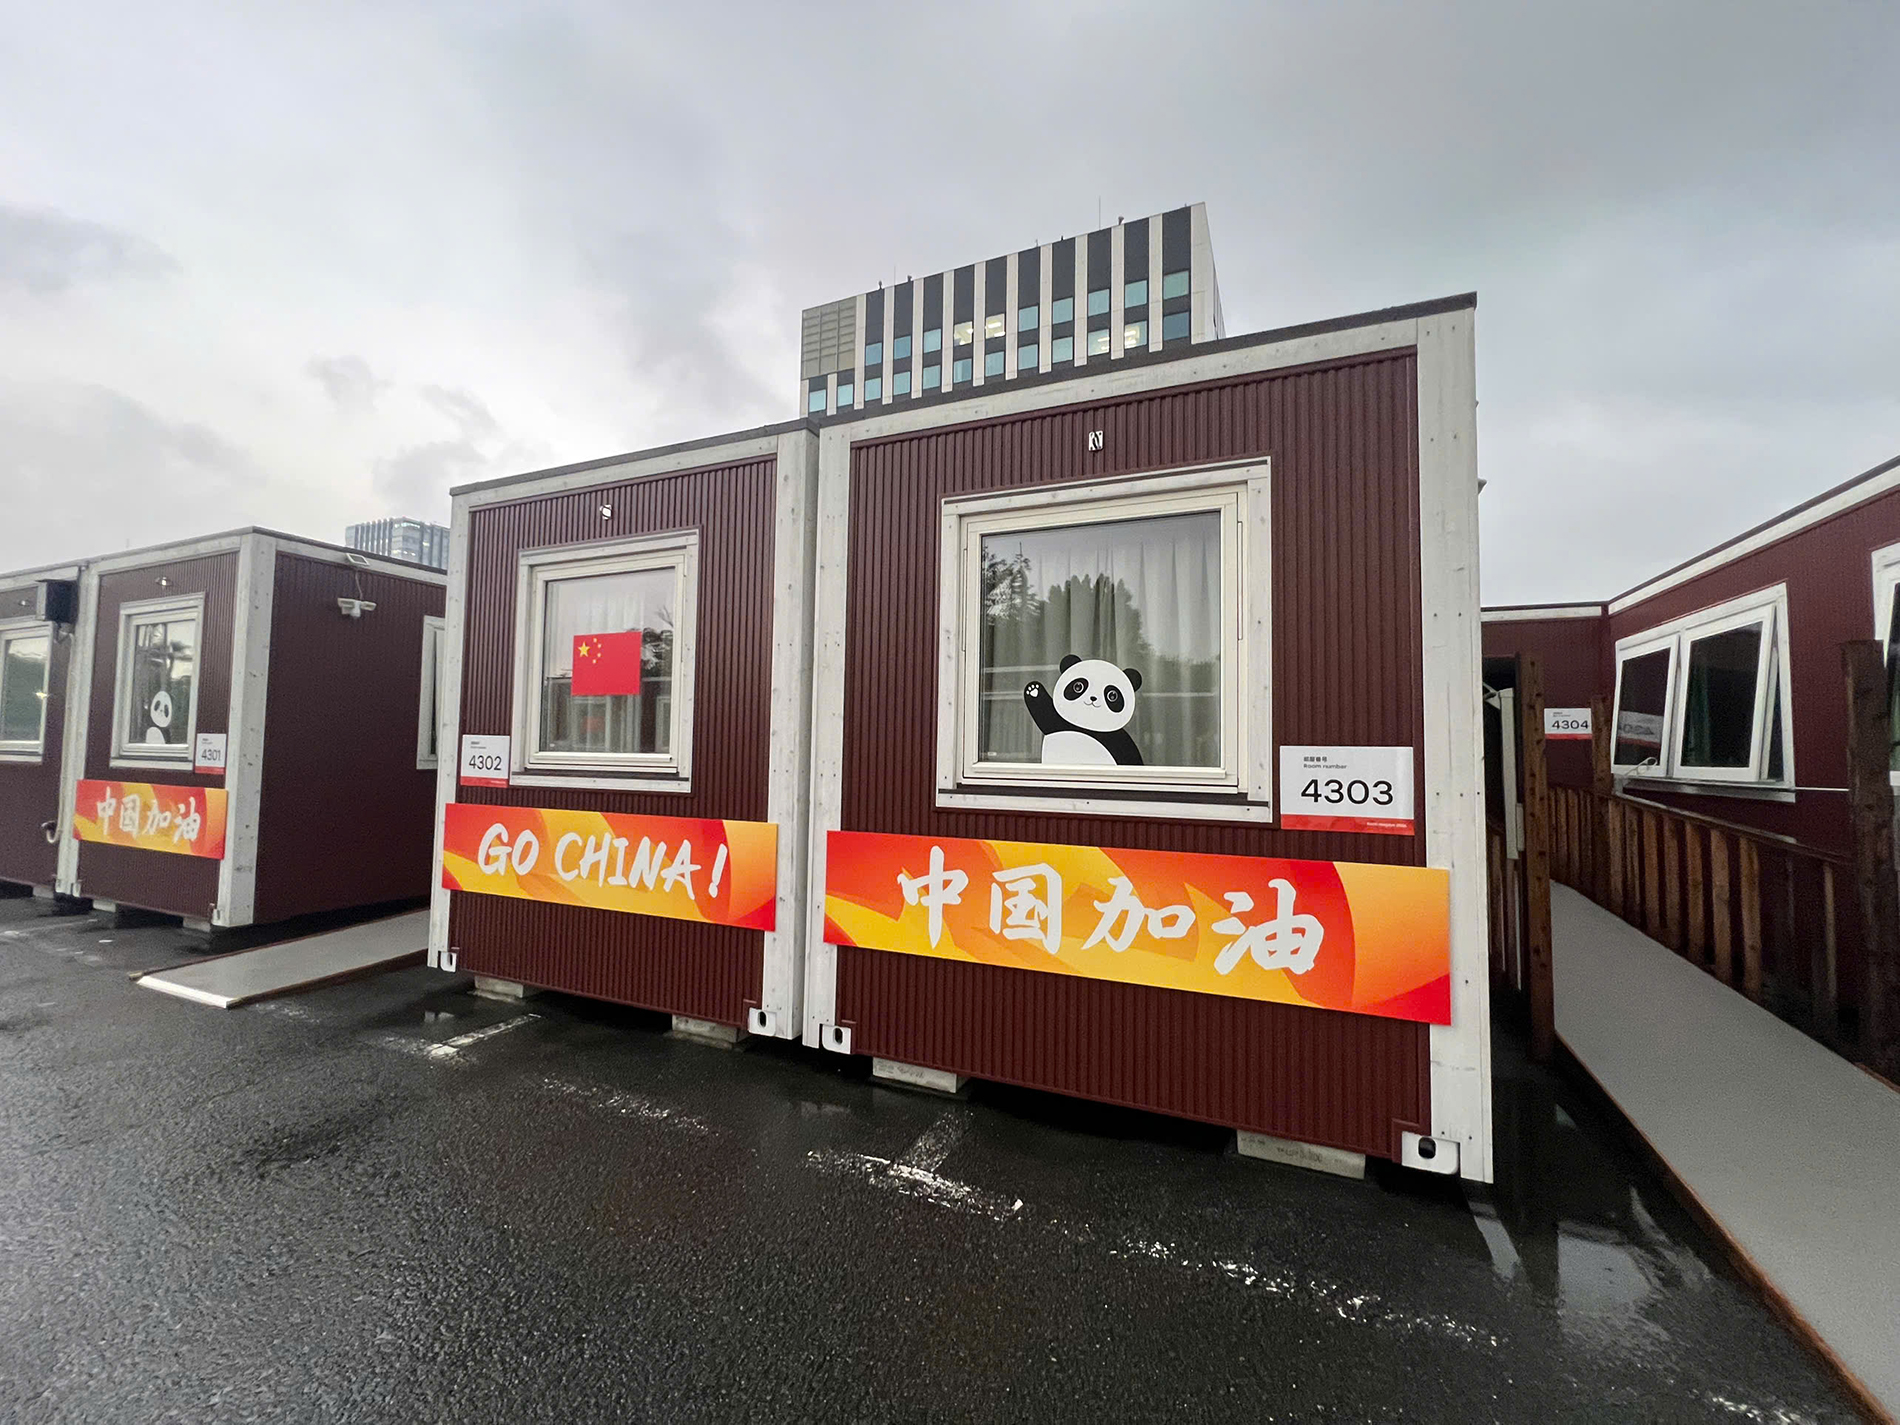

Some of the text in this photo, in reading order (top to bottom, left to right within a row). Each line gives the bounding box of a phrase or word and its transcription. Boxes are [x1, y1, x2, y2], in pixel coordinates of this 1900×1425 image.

[1552, 720, 1588, 729] 4304
[201, 749, 221, 760] 4301
[469, 755, 502, 770] 4302
[1301, 779, 1394, 806] 4303
[96, 786, 201, 844] 中国加油
[478, 823, 728, 900] GO CHINA!
[897, 845, 1325, 976] 中国加油
